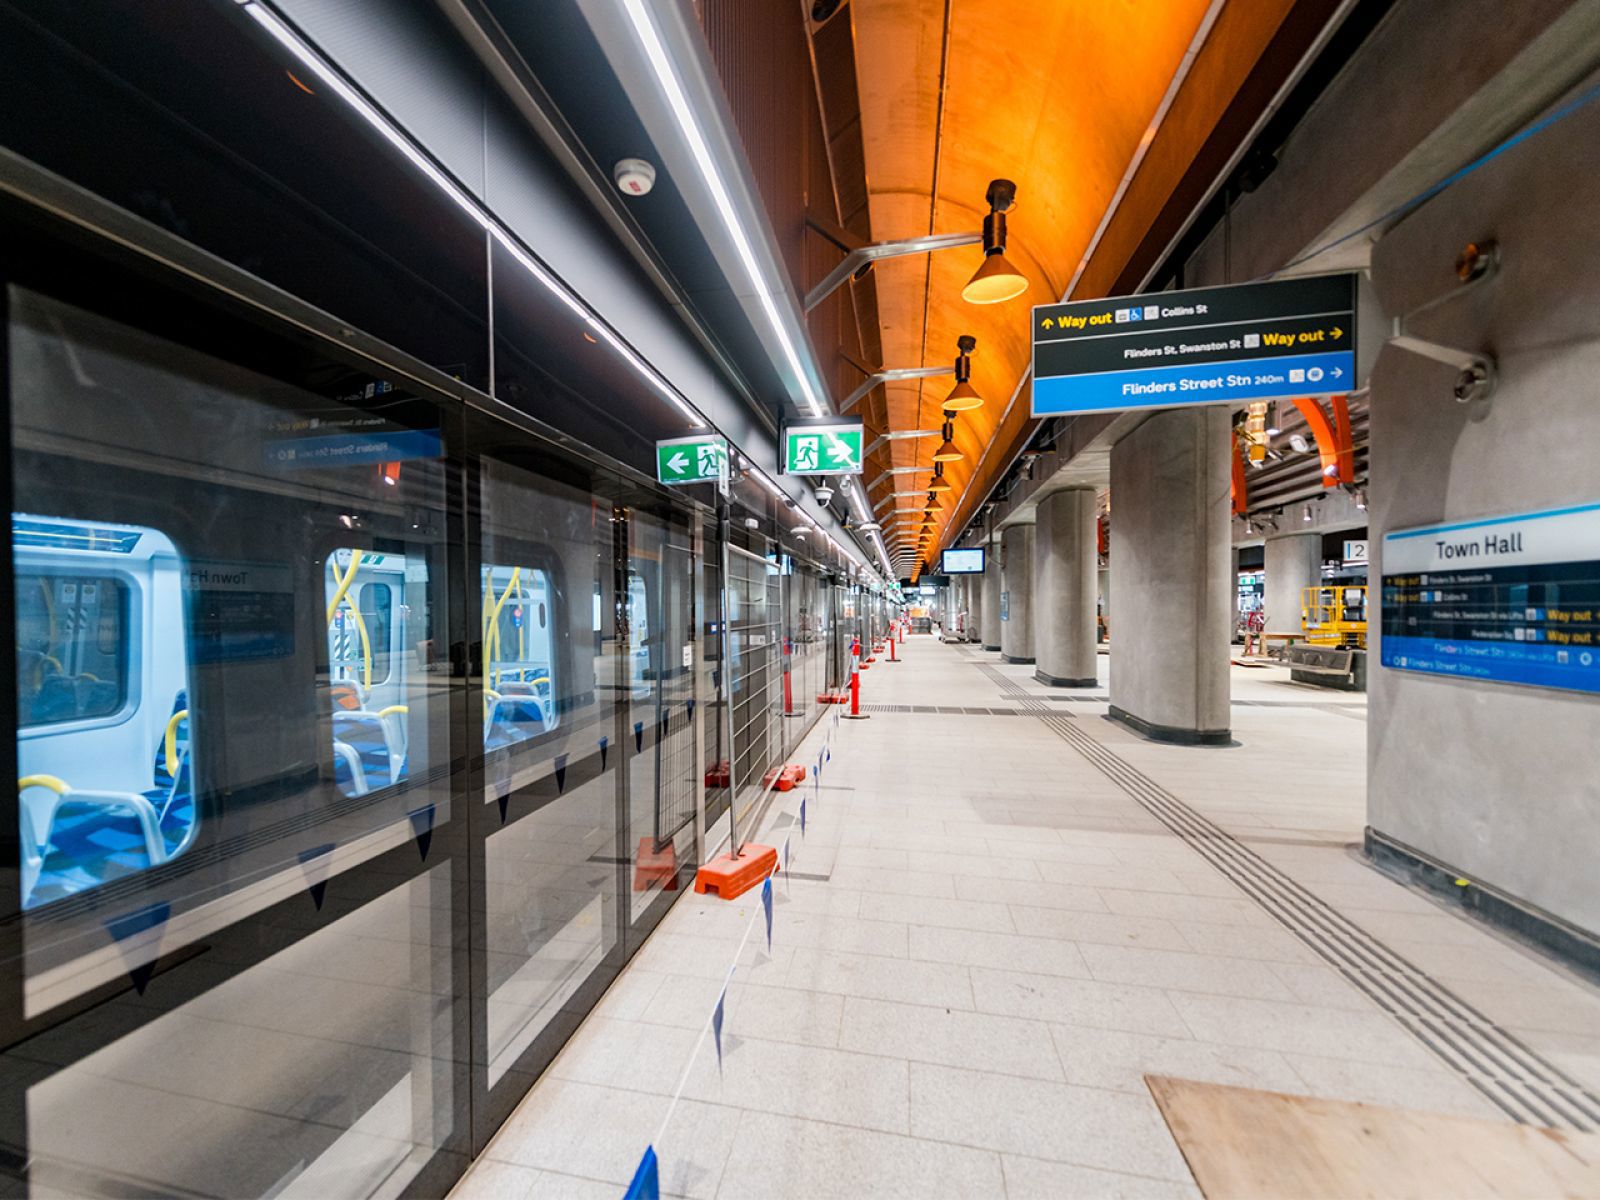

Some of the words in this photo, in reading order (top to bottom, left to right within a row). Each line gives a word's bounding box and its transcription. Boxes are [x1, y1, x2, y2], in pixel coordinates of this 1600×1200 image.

[1161, 306, 1195, 318] Collins
[1195, 304, 1208, 314] St
[1057, 315, 1087, 330] Way
[1089, 312, 1113, 325] out
[1263, 332, 1296, 347] Way
[1298, 329, 1325, 343] out
[1124, 347, 1163, 359] Flinders
[1179, 341, 1229, 354] Swanston
[1229, 339, 1241, 349] St
[1122, 382, 1177, 396] Flinders
[1179, 376, 1224, 391] Street
[1226, 374, 1252, 387] Stn
[1254, 374, 1285, 386] 240m
[1354, 543, 1365, 557] 2
[1436, 540, 1480, 560] Town
[1484, 532, 1524, 556] Hall
[1547, 608, 1571, 622] Way
[1572, 608, 1592, 621] out
[1547, 629, 1571, 645] Way
[1572, 631, 1592, 644] out
